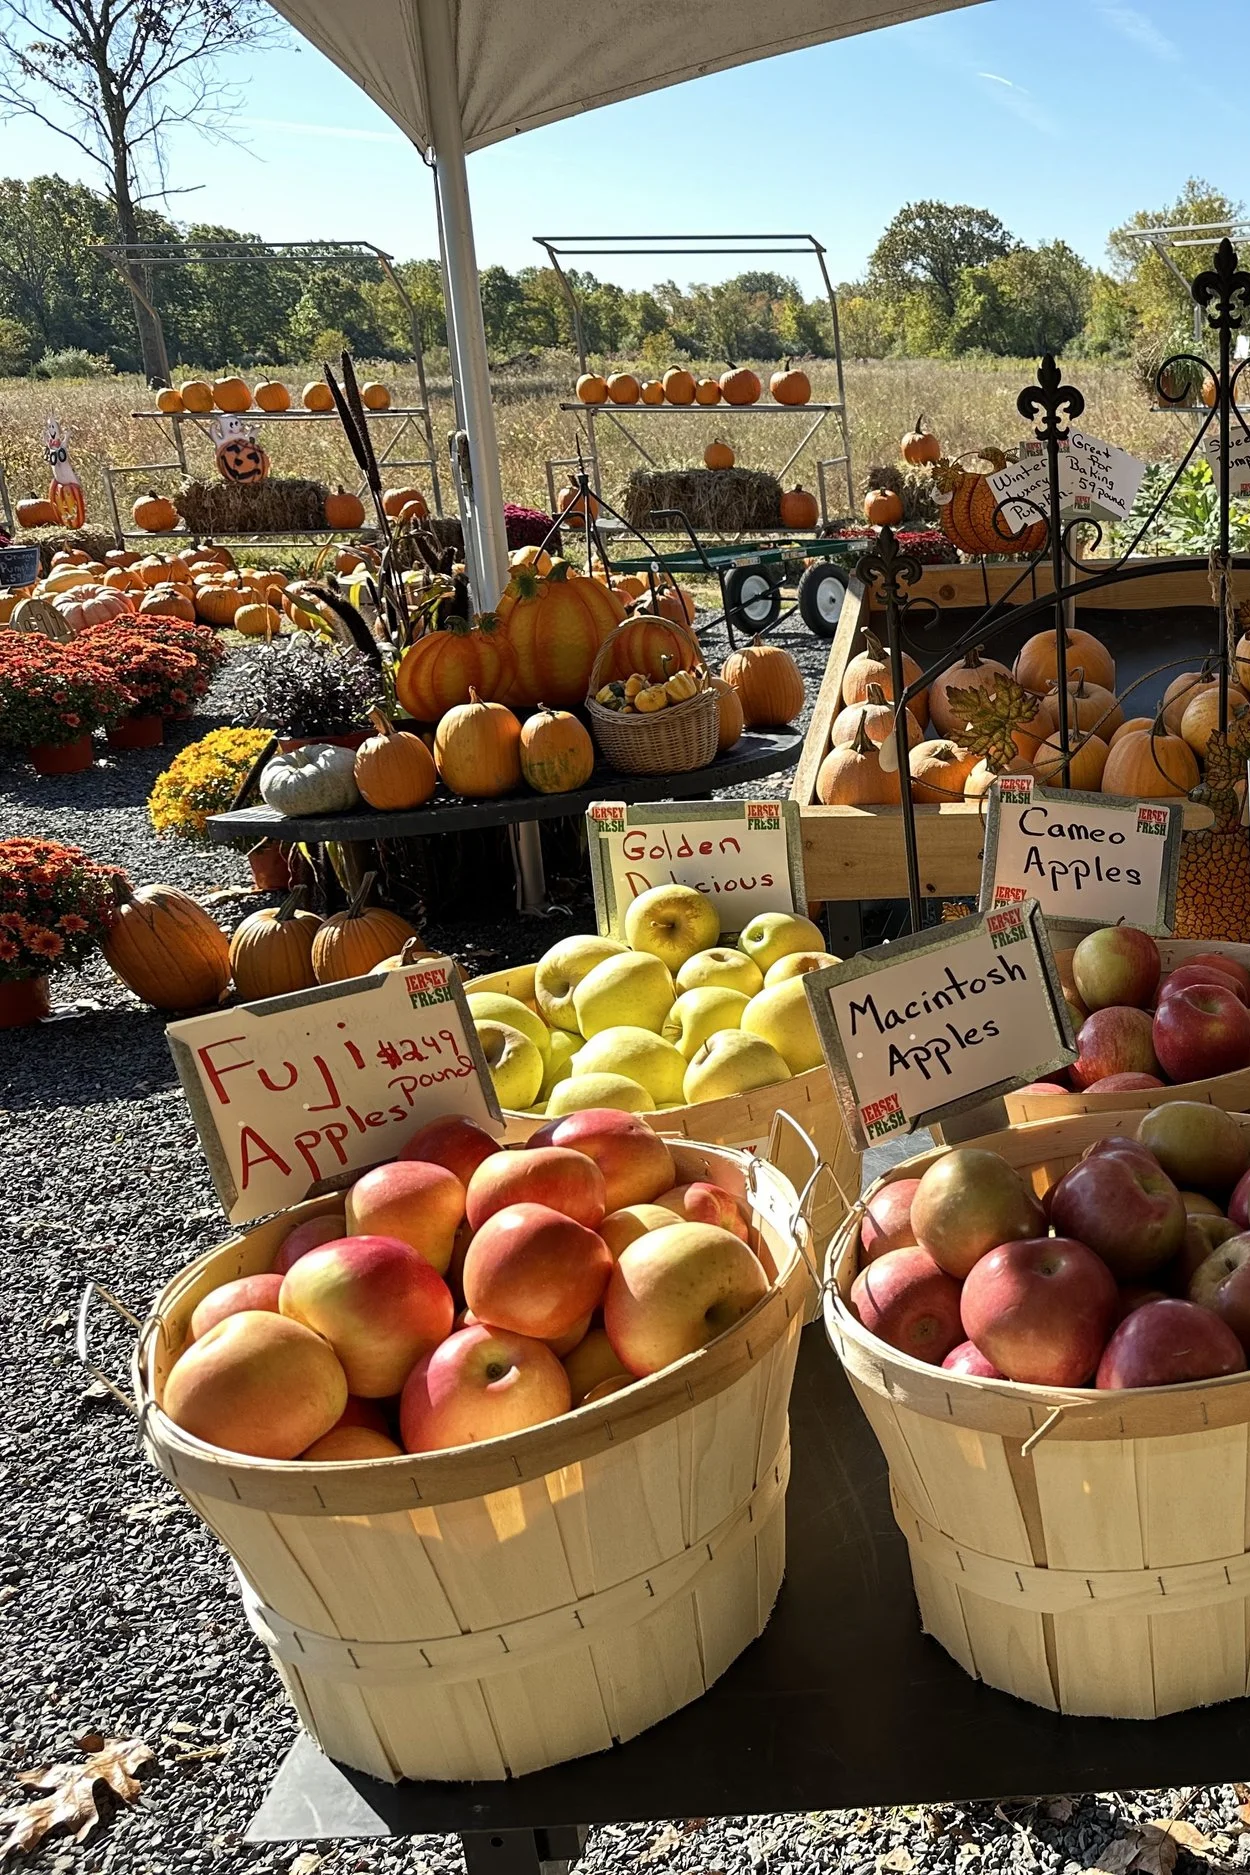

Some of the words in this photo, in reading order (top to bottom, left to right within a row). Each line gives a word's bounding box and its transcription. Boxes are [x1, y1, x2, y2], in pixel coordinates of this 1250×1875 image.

[1072, 433, 1111, 458] Great
[993, 458, 1048, 491] Winter
[1065, 455, 1114, 491] Baking
[1096, 487, 1127, 511] pound
[1000, 778, 1032, 791] JERSEY
[747, 804, 780, 818] JERSEY
[1000, 792, 1031, 805] FRESH
[591, 806, 624, 819] JERSEY
[747, 818, 780, 831] FRESH
[1138, 808, 1168, 823] JERSEY
[598, 820, 625, 832] RESH
[1018, 807, 1125, 844] Cameo
[1136, 821, 1166, 836] FRESH
[622, 829, 741, 861] Golden
[1023, 846, 1141, 892] Apples
[625, 870, 774, 898] Dcious
[995, 886, 1027, 901] JERSEY
[986, 907, 1022, 933] JERSEY
[991, 925, 1028, 949] FRESH
[405, 968, 448, 992] JERSEY
[411, 986, 453, 1009] FRESH
[848, 954, 1027, 1036] Macintosh
[888, 1019, 1000, 1080] Apples
[197, 1022, 366, 1112] Fuji
[388, 1055, 477, 1106] pound
[861, 1093, 901, 1123] JERSEY
[867, 1111, 906, 1140] FRESH
[241, 1104, 408, 1190] Apples
